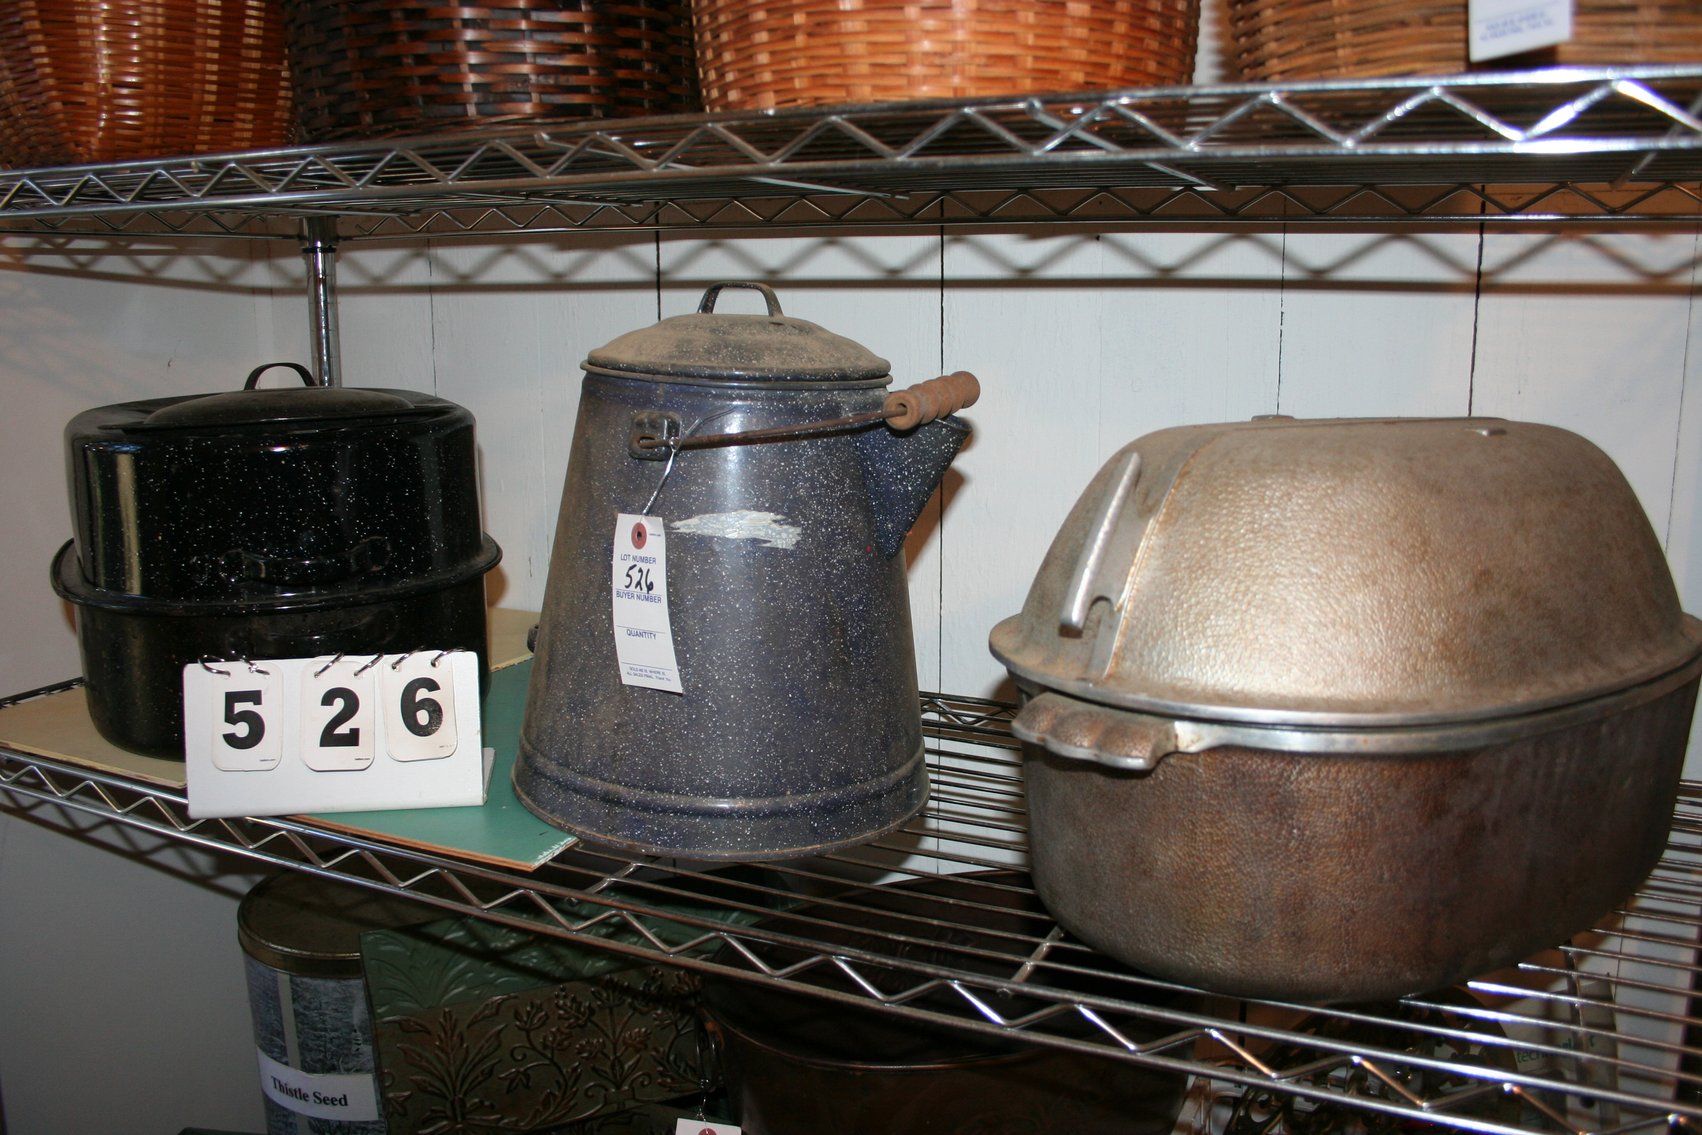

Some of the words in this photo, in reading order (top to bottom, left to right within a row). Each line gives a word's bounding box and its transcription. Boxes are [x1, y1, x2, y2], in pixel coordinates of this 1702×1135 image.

[620, 553, 631, 562] LOT
[632, 555, 657, 565] NUMBER
[624, 563, 655, 594] 526
[616, 590, 635, 600] BUYER
[636, 593, 662, 604] NUMBER
[626, 629, 657, 640] QUANTITY
[270, 1075, 310, 1102] Thistle
[312, 1090, 349, 1107] Seed
